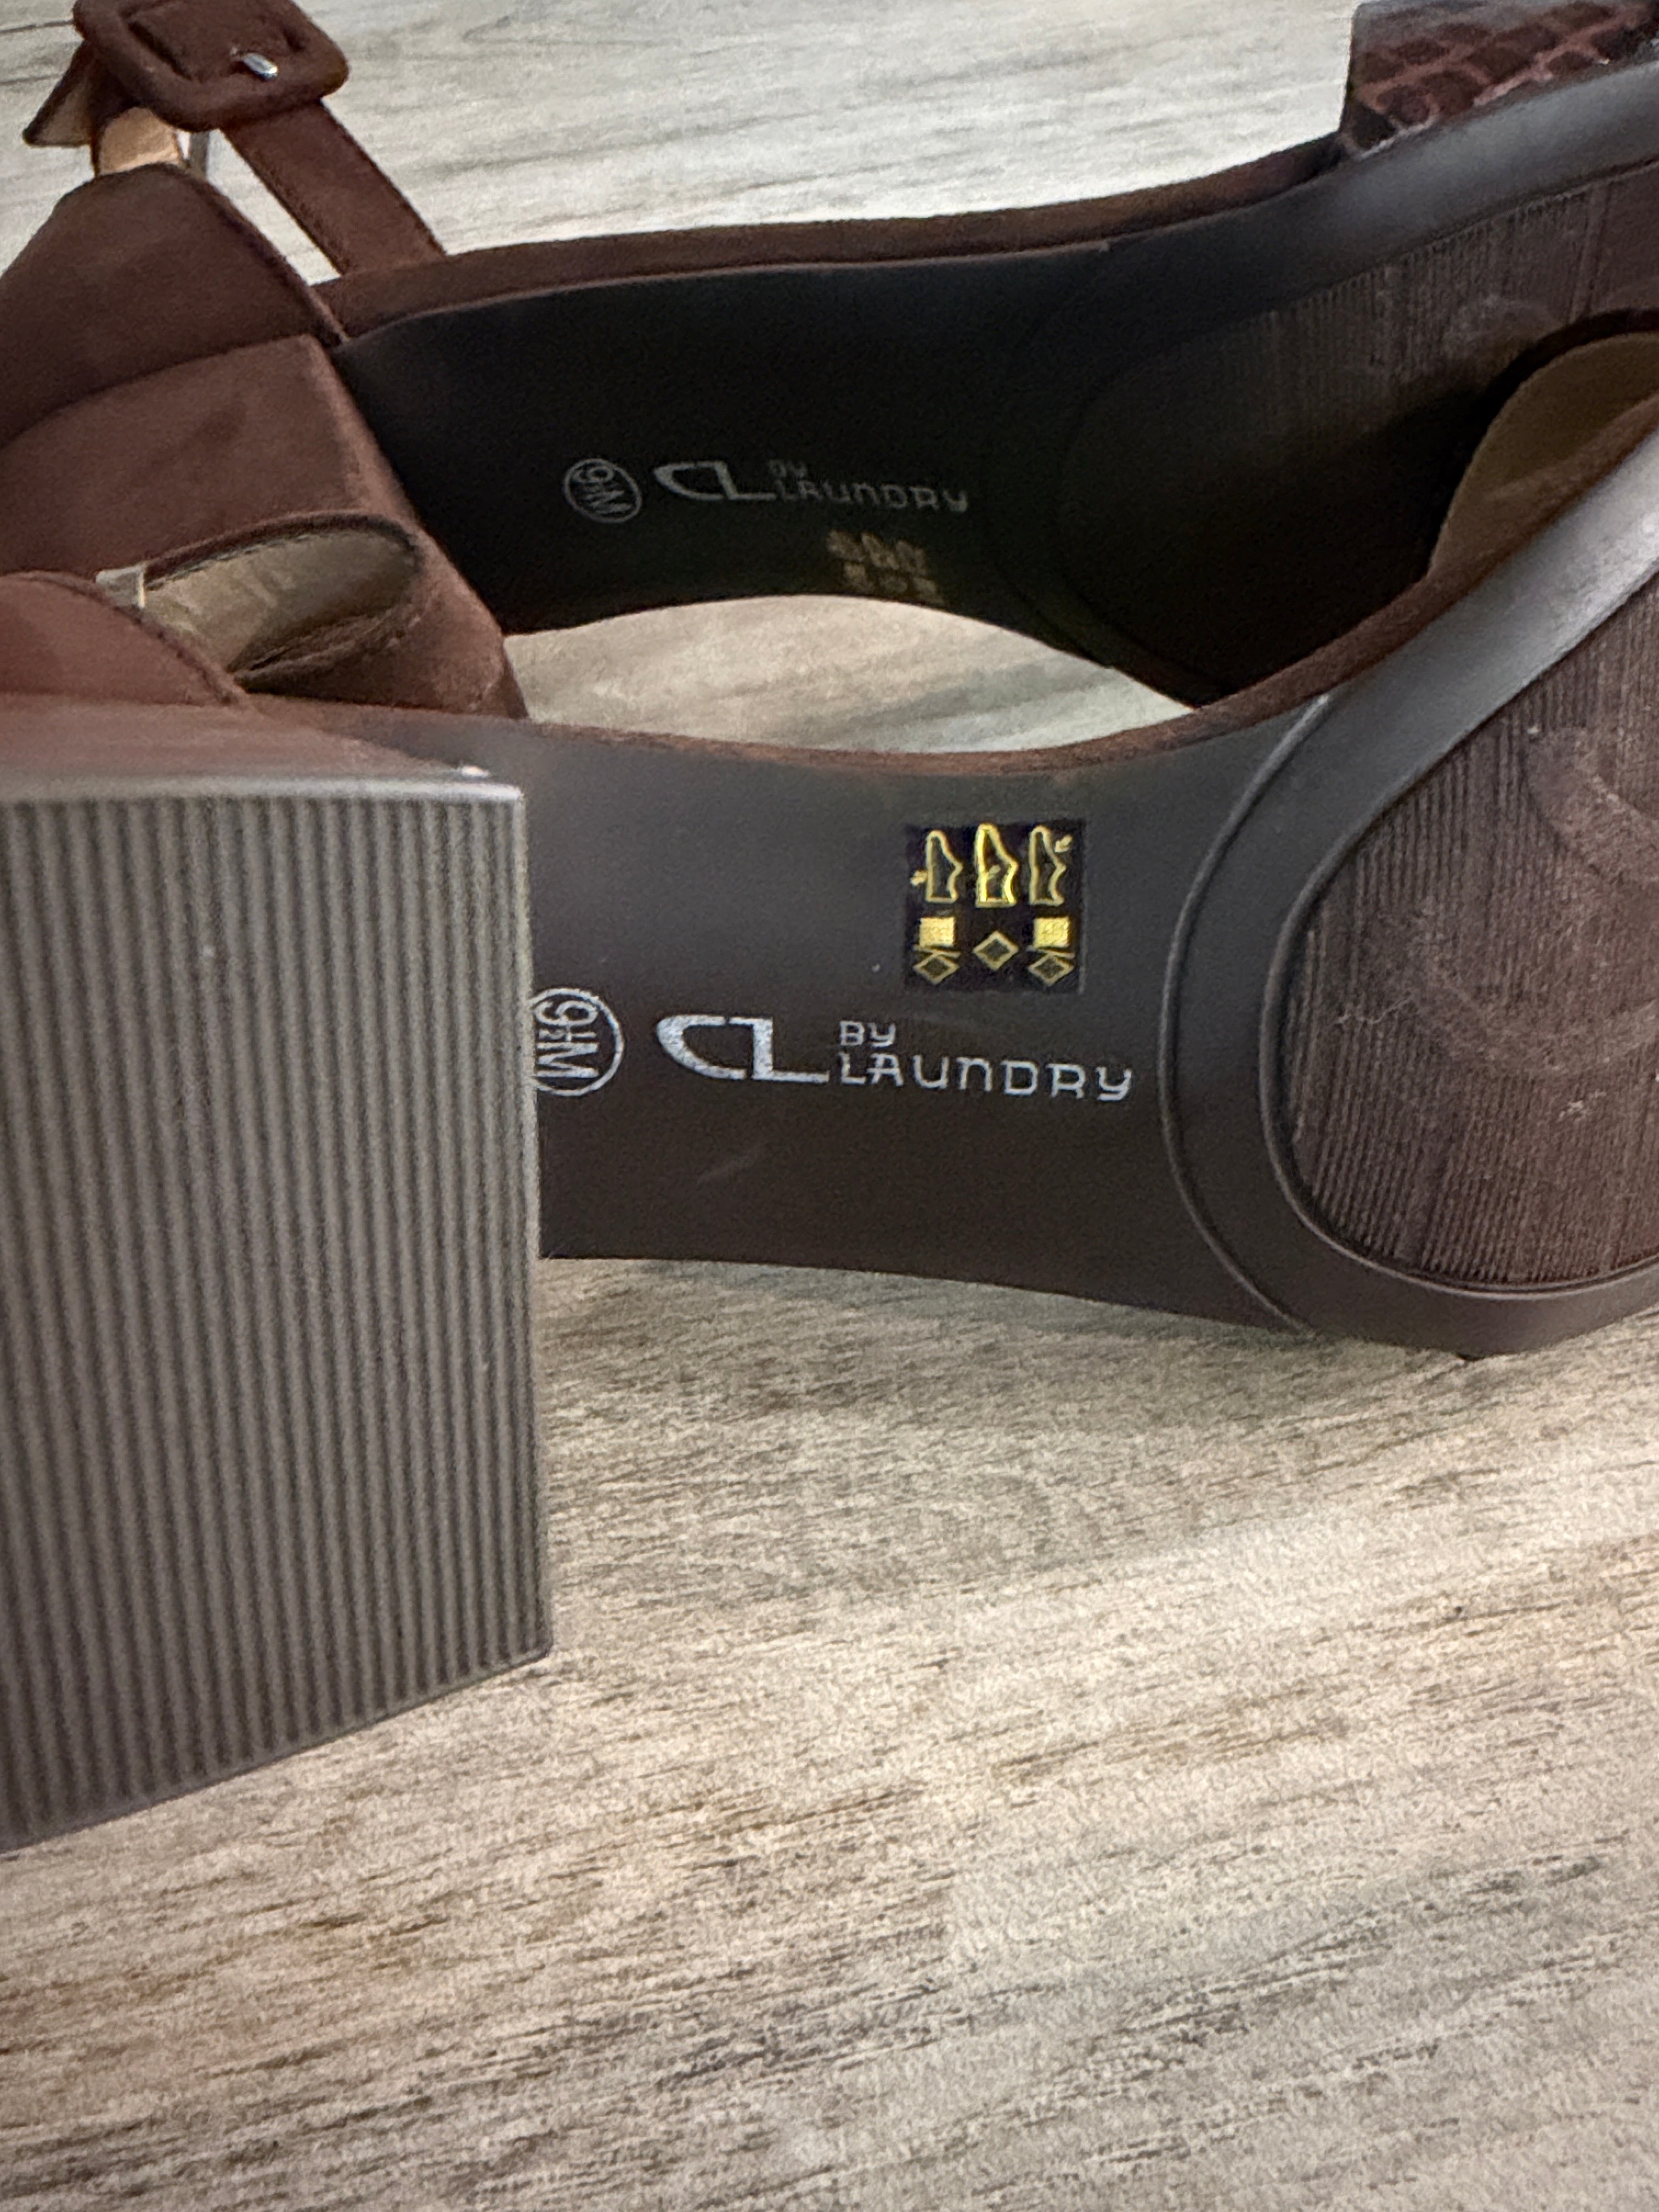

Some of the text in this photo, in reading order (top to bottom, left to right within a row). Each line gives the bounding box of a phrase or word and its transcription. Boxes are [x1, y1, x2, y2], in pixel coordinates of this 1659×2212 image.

[774, 478, 968, 513] LAUNDRY
[839, 1019, 896, 1048] BY
[837, 1051, 1132, 1101] LAUNDRY
